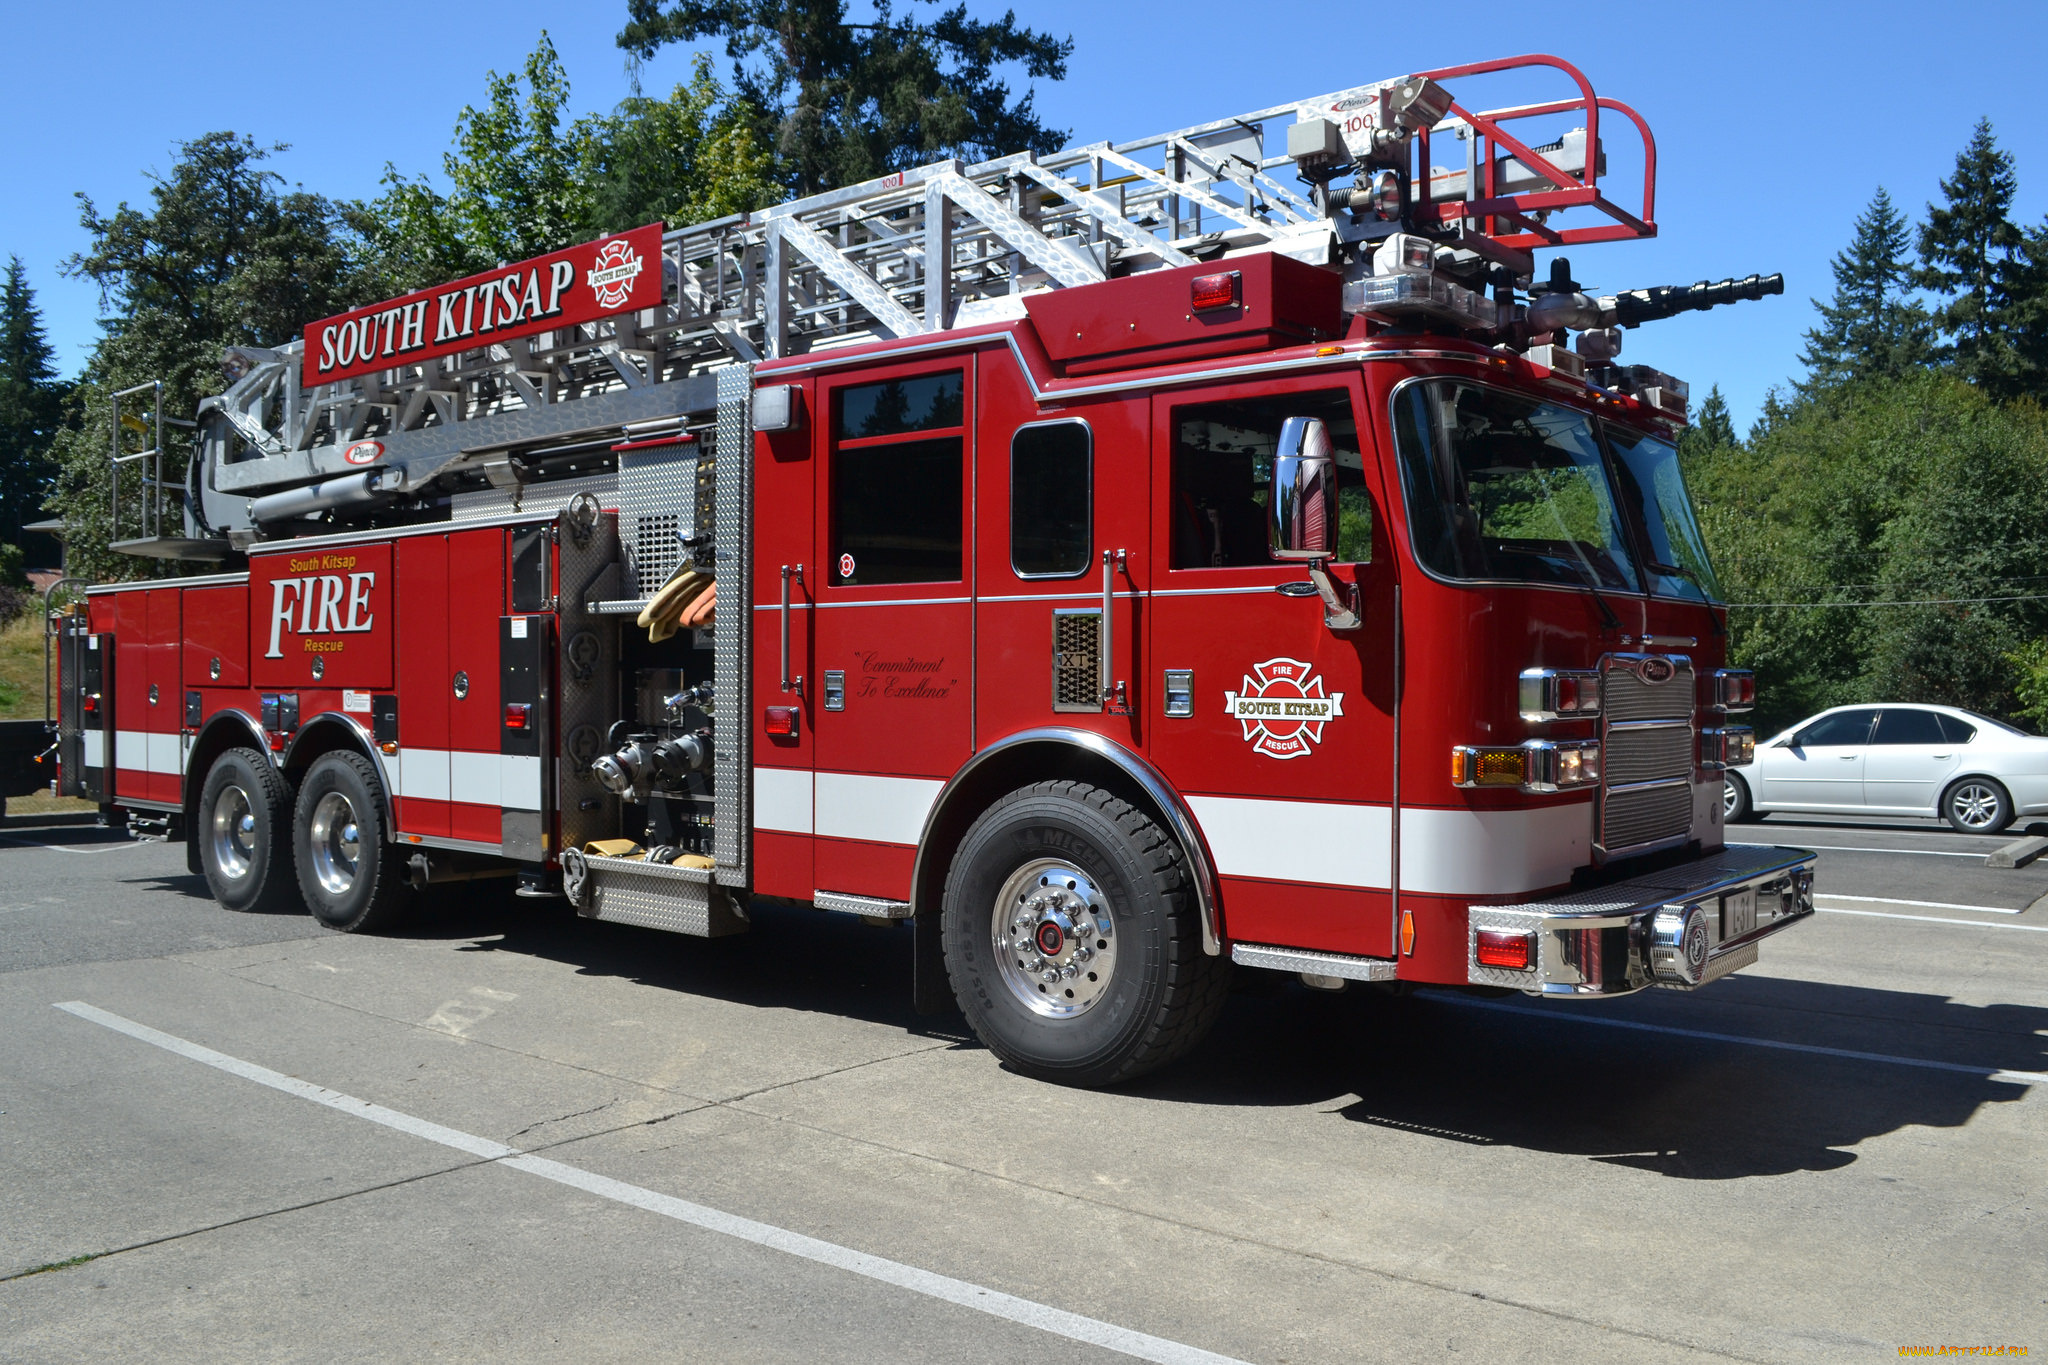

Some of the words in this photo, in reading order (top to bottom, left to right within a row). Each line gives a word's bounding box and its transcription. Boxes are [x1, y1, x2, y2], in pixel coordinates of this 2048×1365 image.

[882, 177, 897, 189] 100
[319, 300, 428, 372] SOUTH
[434, 260, 575, 342] KITSAP
[290, 557, 319, 572] South
[322, 555, 356, 571] Kitsap
[264, 572, 375, 659] FIRE
[304, 639, 344, 652] Rescue
[1062, 654, 1087, 666] XT
[1272, 666, 1293, 675] FIRE
[857, 676, 879, 698] To
[1238, 702, 1281, 715] SOUTH
[1284, 702, 1329, 716] KITSAP
[1265, 739, 1299, 751] RESCUE
